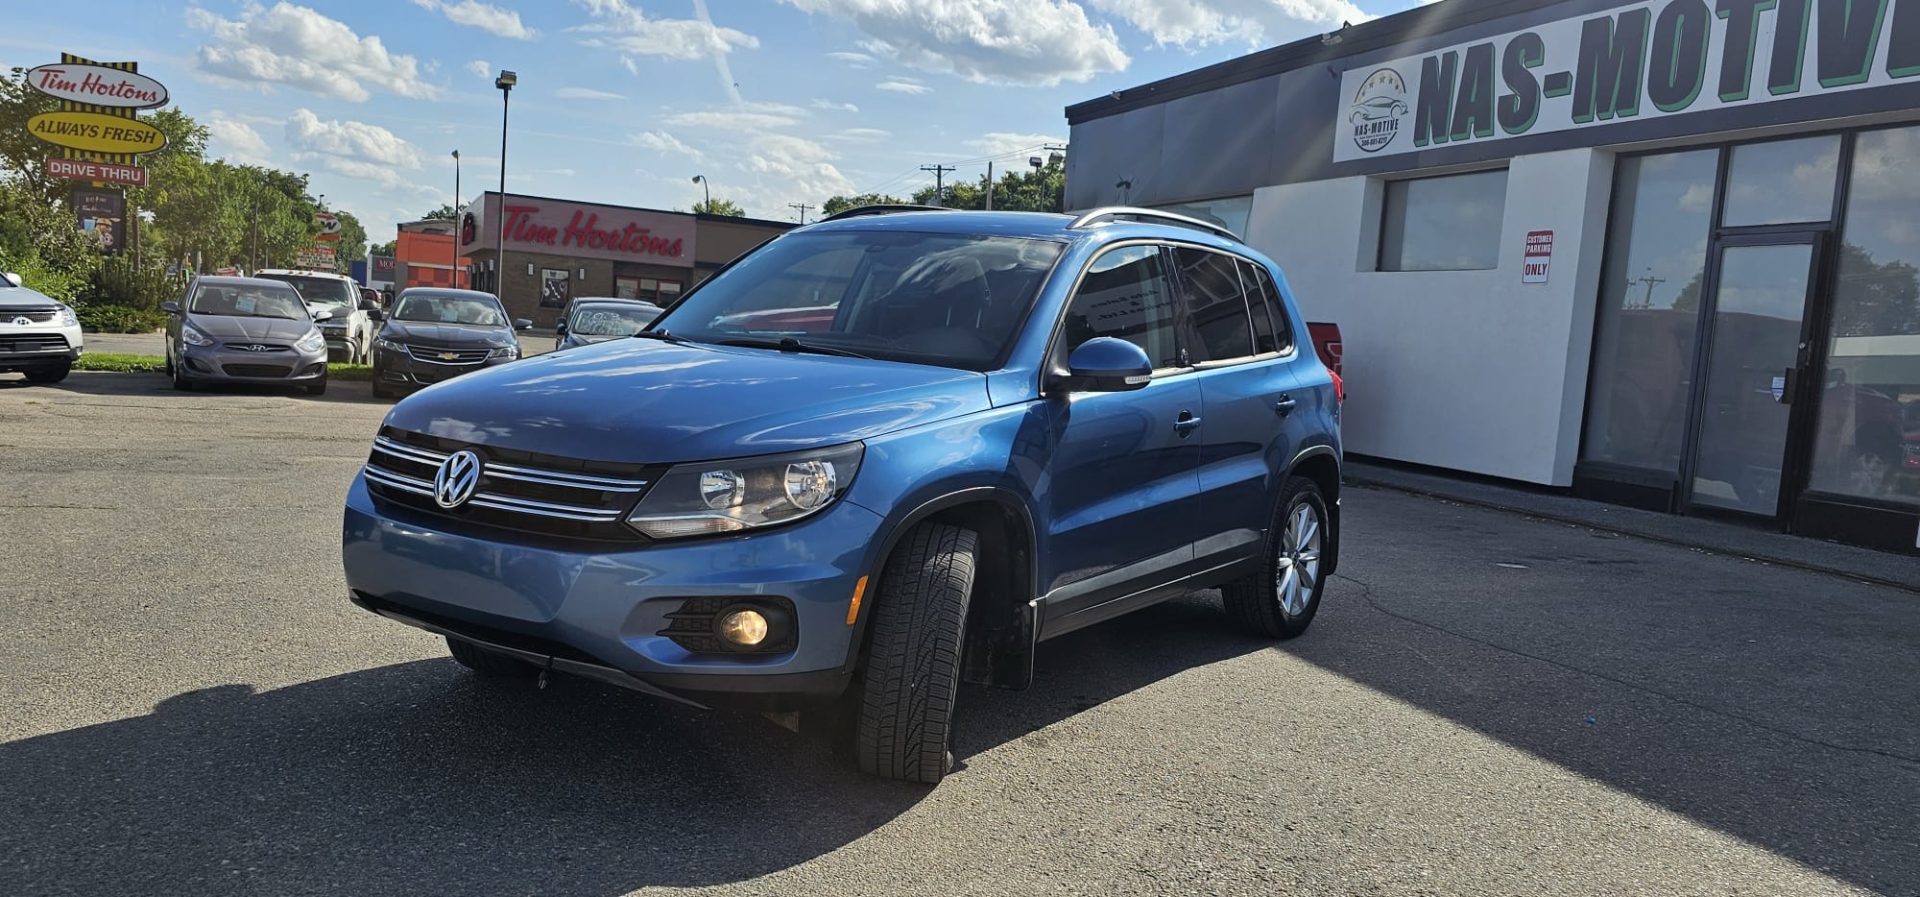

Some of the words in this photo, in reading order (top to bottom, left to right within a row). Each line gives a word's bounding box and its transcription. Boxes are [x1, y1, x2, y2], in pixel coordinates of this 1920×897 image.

[39, 69, 76, 93] Tim
[80, 72, 157, 103] Hortons
[35, 119, 99, 138] ALWAYS
[102, 127, 156, 144] FRESH
[1354, 119, 1399, 136] NAS-MOTIVE
[50, 161, 96, 177] DRIVE
[100, 166, 142, 182] THRU
[502, 205, 559, 247] Tim
[562, 209, 684, 258] Hortons
[1527, 235, 1552, 243] CUSTOMER
[1527, 244, 1551, 253] PARKING
[1525, 263, 1548, 276] ONLY
